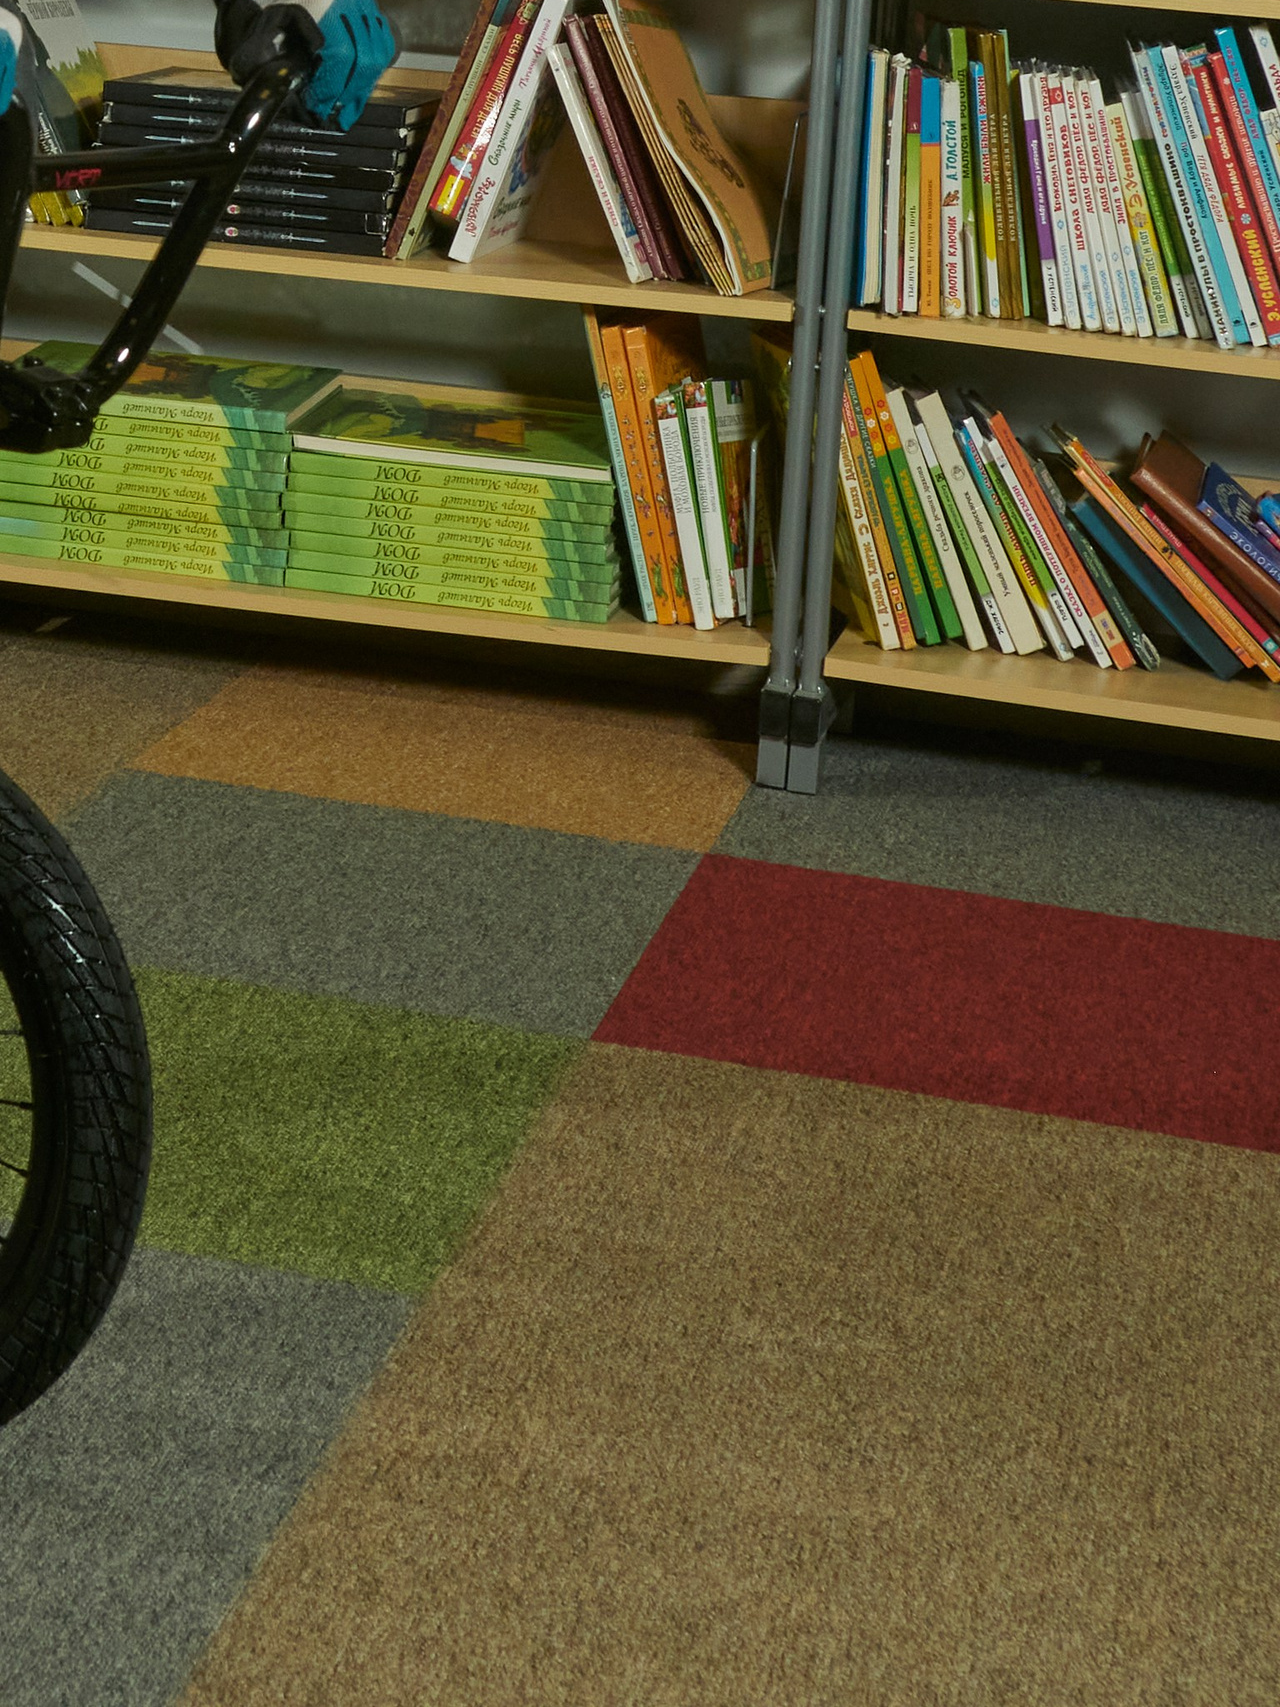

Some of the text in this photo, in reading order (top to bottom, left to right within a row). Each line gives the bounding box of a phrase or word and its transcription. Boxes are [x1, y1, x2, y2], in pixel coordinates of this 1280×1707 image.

[508, 31, 526, 56] ВЕСЬ
[490, 53, 517, 94] ПУШКИН
[1198, 69, 1219, 115] МУЛЬТИКИ
[481, 91, 499, 114] ДЛЯ
[1167, 61, 1200, 141] Эдуард Успенский
[1107, 114, 1138, 191] Успенский
[1213, 123, 1232, 160] СКАЗКИ
[585, 153, 606, 190] СКАЗКИ
[987, 112, 1004, 241] КОЛЫБЕЛЬНАЯ ДЛЯ ВЕТРА
[1058, 123, 1075, 206] СНЕГОВИКОВ
[1224, 160, 1247, 211] ЛЮБИМЫЕ
[602, 197, 620, 228] СТИХИ
[907, 204, 916, 227] НОЧЬ
[1161, 140, 1204, 254] ПРОСТОКВАШИНО
[907, 229, 915, 252] ОДНА
[945, 213, 958, 256] КЛЮЧИК
[906, 266, 916, 298] ТЫСЯЧА
[1241, 226, 1277, 308] УСПЕНСКИЙ
[1197, 262, 1229, 336] КАНИКУЛЫ
[56, 450, 214, 483] Игорь Малышев ДОМ
[686, 415, 710, 515] НОВЫЕ ПРИКЛЮЧЕНИЯ
[915, 464, 951, 553] Свадьба речного дракона
[1010, 482, 1036, 524] ВРЕМЕНИ
[1029, 520, 1064, 578] ПОТЕРЯННОМ
[1061, 583, 1084, 619] СКАЗКА
